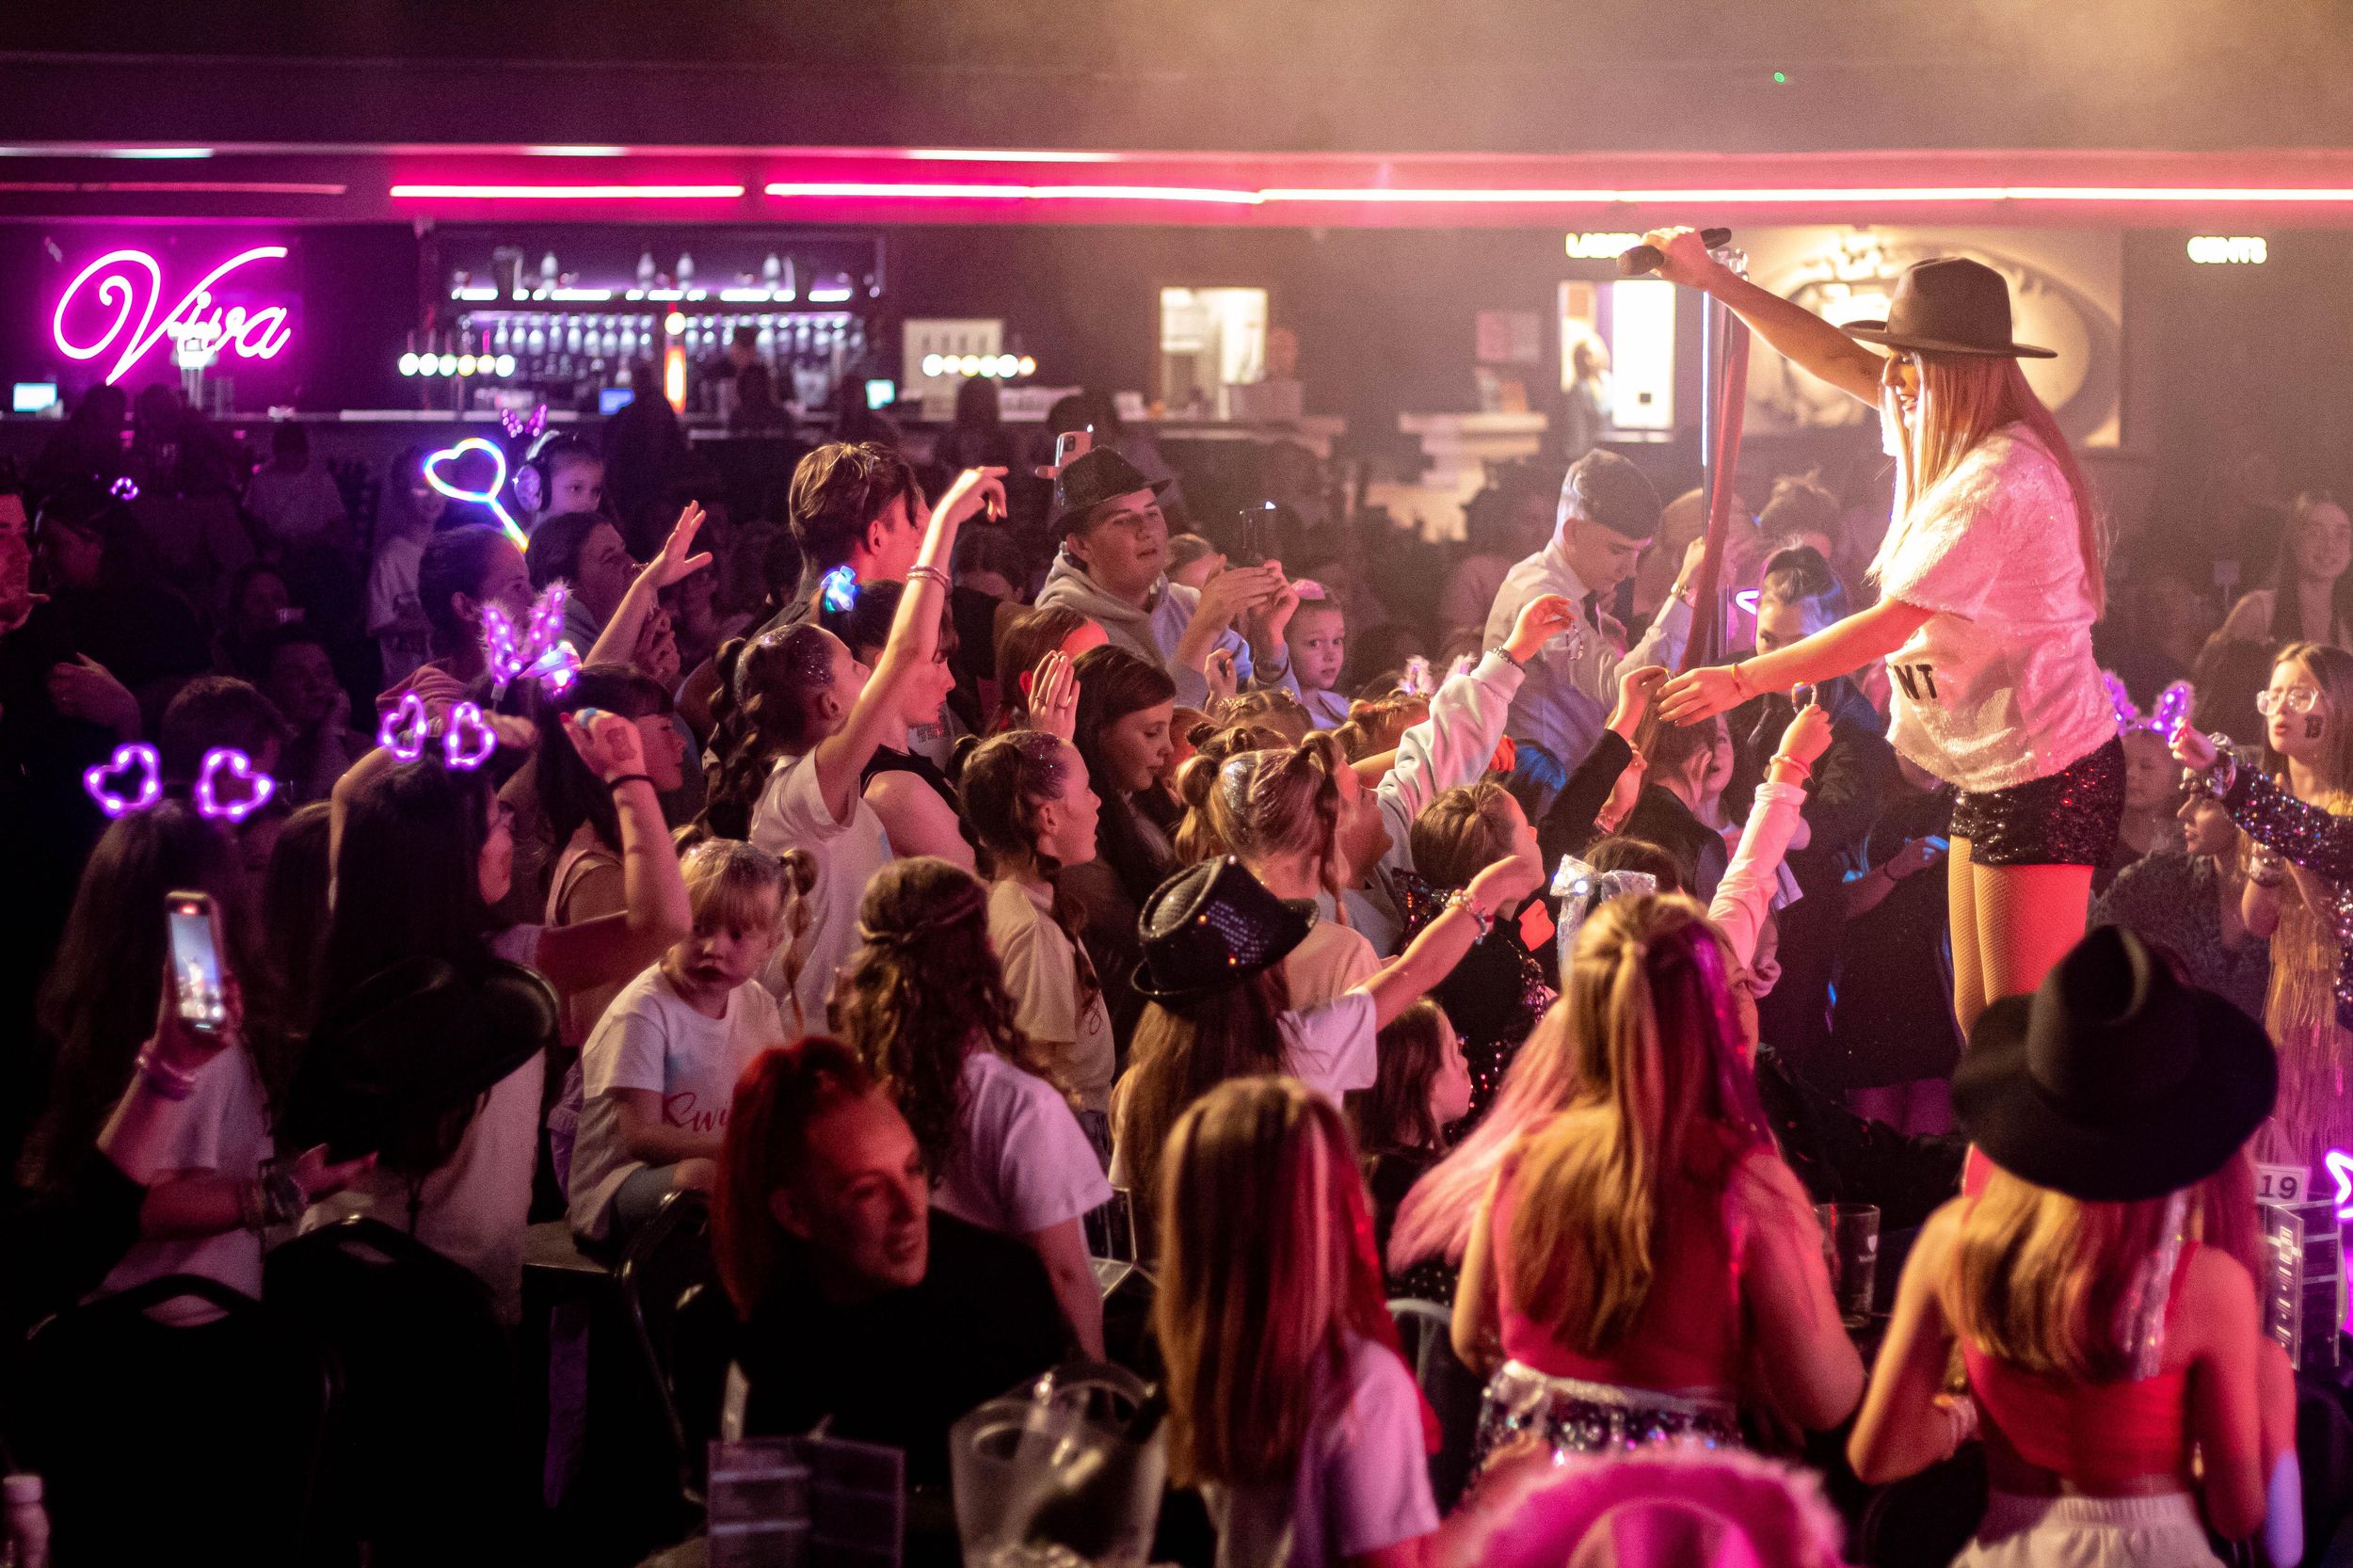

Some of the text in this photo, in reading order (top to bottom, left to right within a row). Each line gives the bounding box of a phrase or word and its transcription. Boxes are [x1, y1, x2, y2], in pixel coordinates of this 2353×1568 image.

[53, 247, 291, 386] Viva
[1887, 664, 1938, 700] NT
[2258, 1175, 2298, 1200] 19
